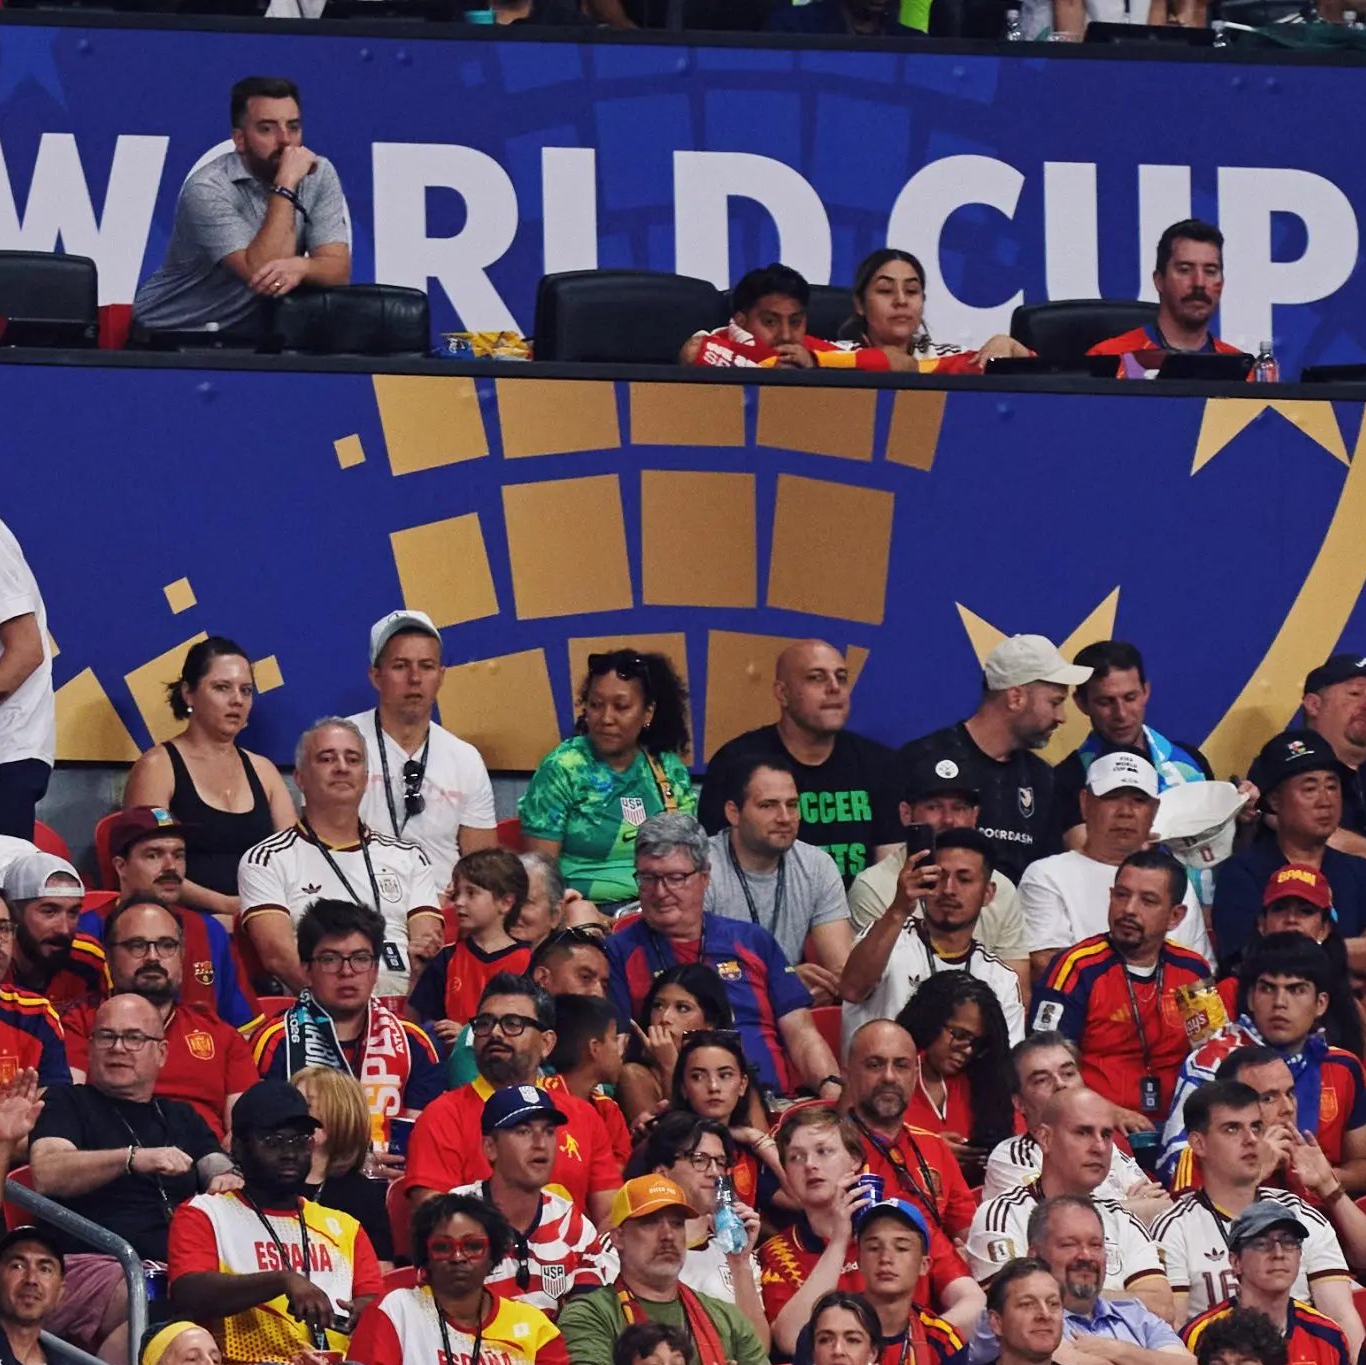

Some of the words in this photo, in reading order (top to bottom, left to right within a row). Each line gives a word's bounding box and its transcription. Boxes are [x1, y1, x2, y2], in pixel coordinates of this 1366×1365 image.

[886, 154, 1359, 358] CUP
[622, 798, 644, 809] USA
[1277, 868, 1316, 887] SPAIN
[254, 1239, 333, 1273] ESPAÑA
[542, 1267, 564, 1280] USA
